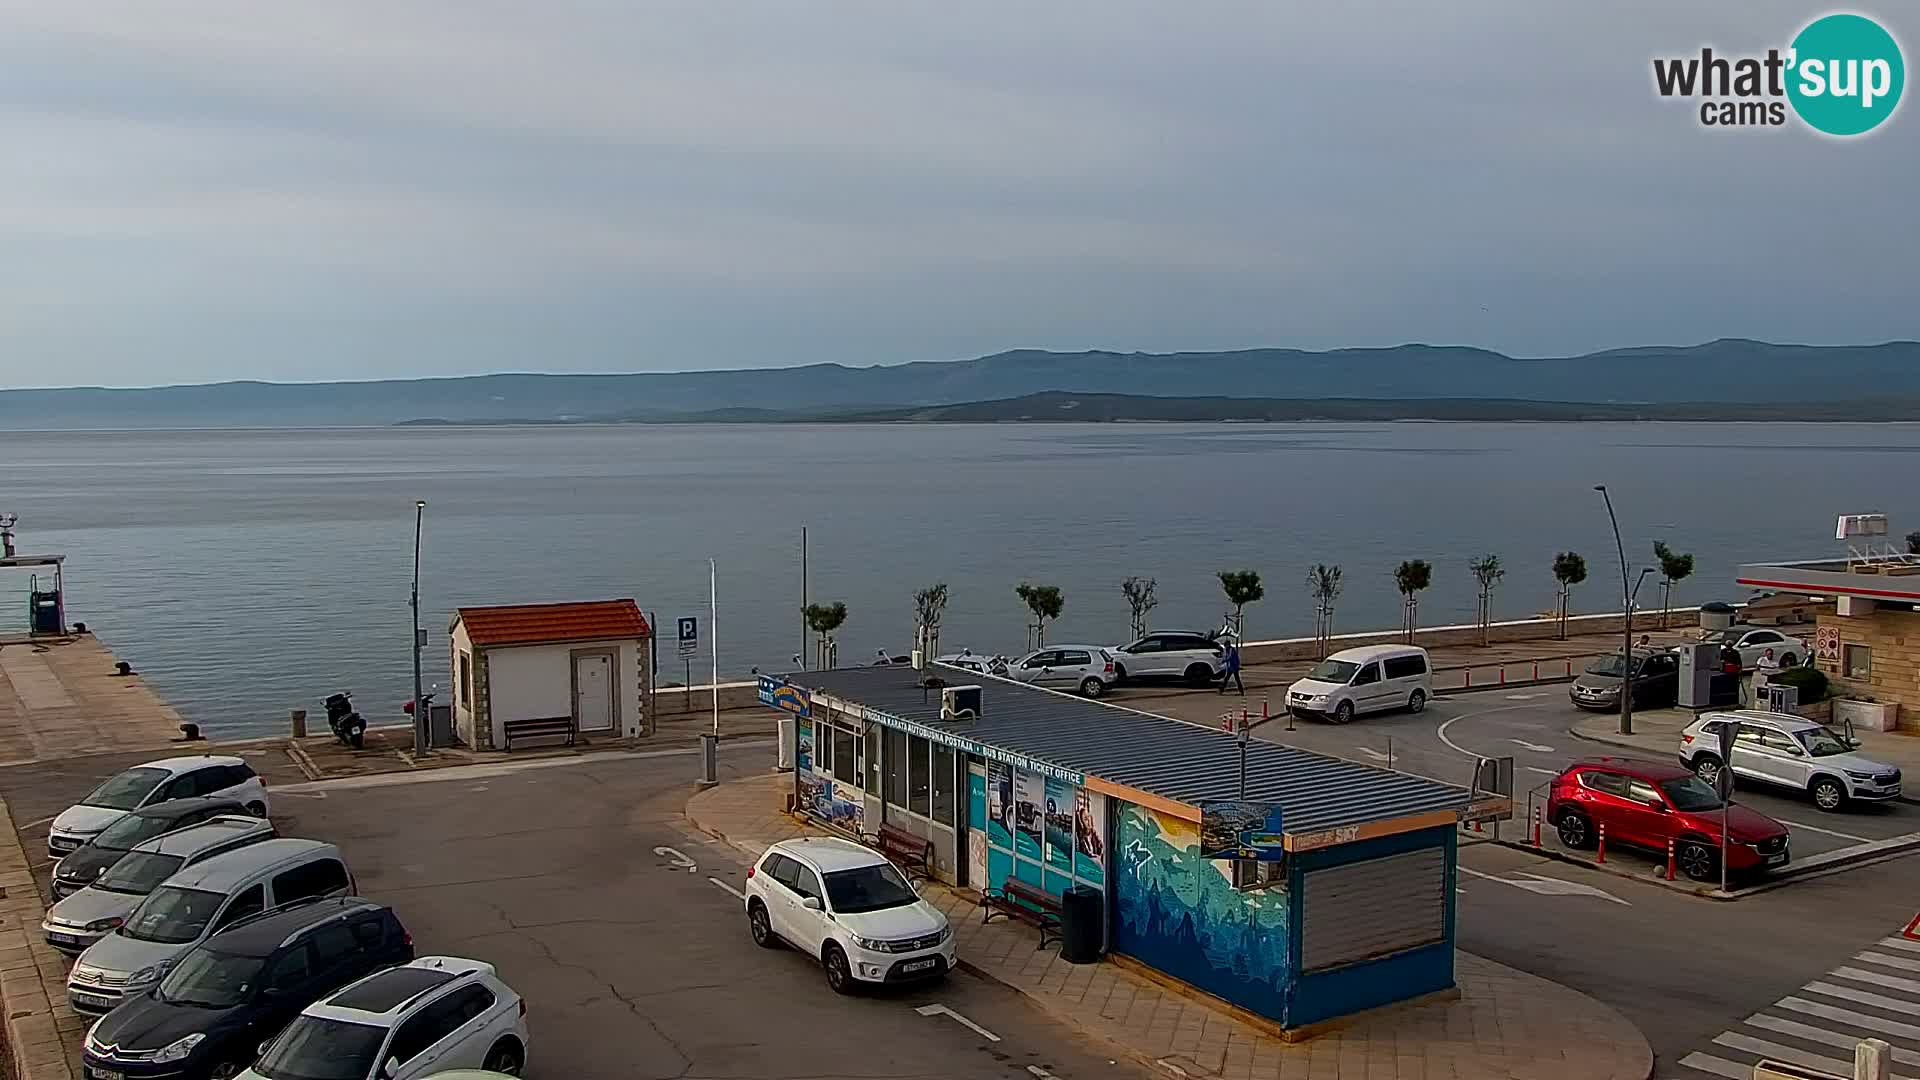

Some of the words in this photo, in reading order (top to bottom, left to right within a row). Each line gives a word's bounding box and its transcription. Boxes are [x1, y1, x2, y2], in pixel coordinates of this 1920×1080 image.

[683, 621, 693, 637] P
[887, 717, 907, 731] KARATA
[908, 723, 944, 743] AUTOBUSNA
[945, 734, 974, 752] POSTAJA
[983, 745, 997, 758] BUS
[998, 751, 1027, 769] STATION
[1029, 761, 1054, 776] TICKET
[1055, 769, 1081, 784] OFFICE
